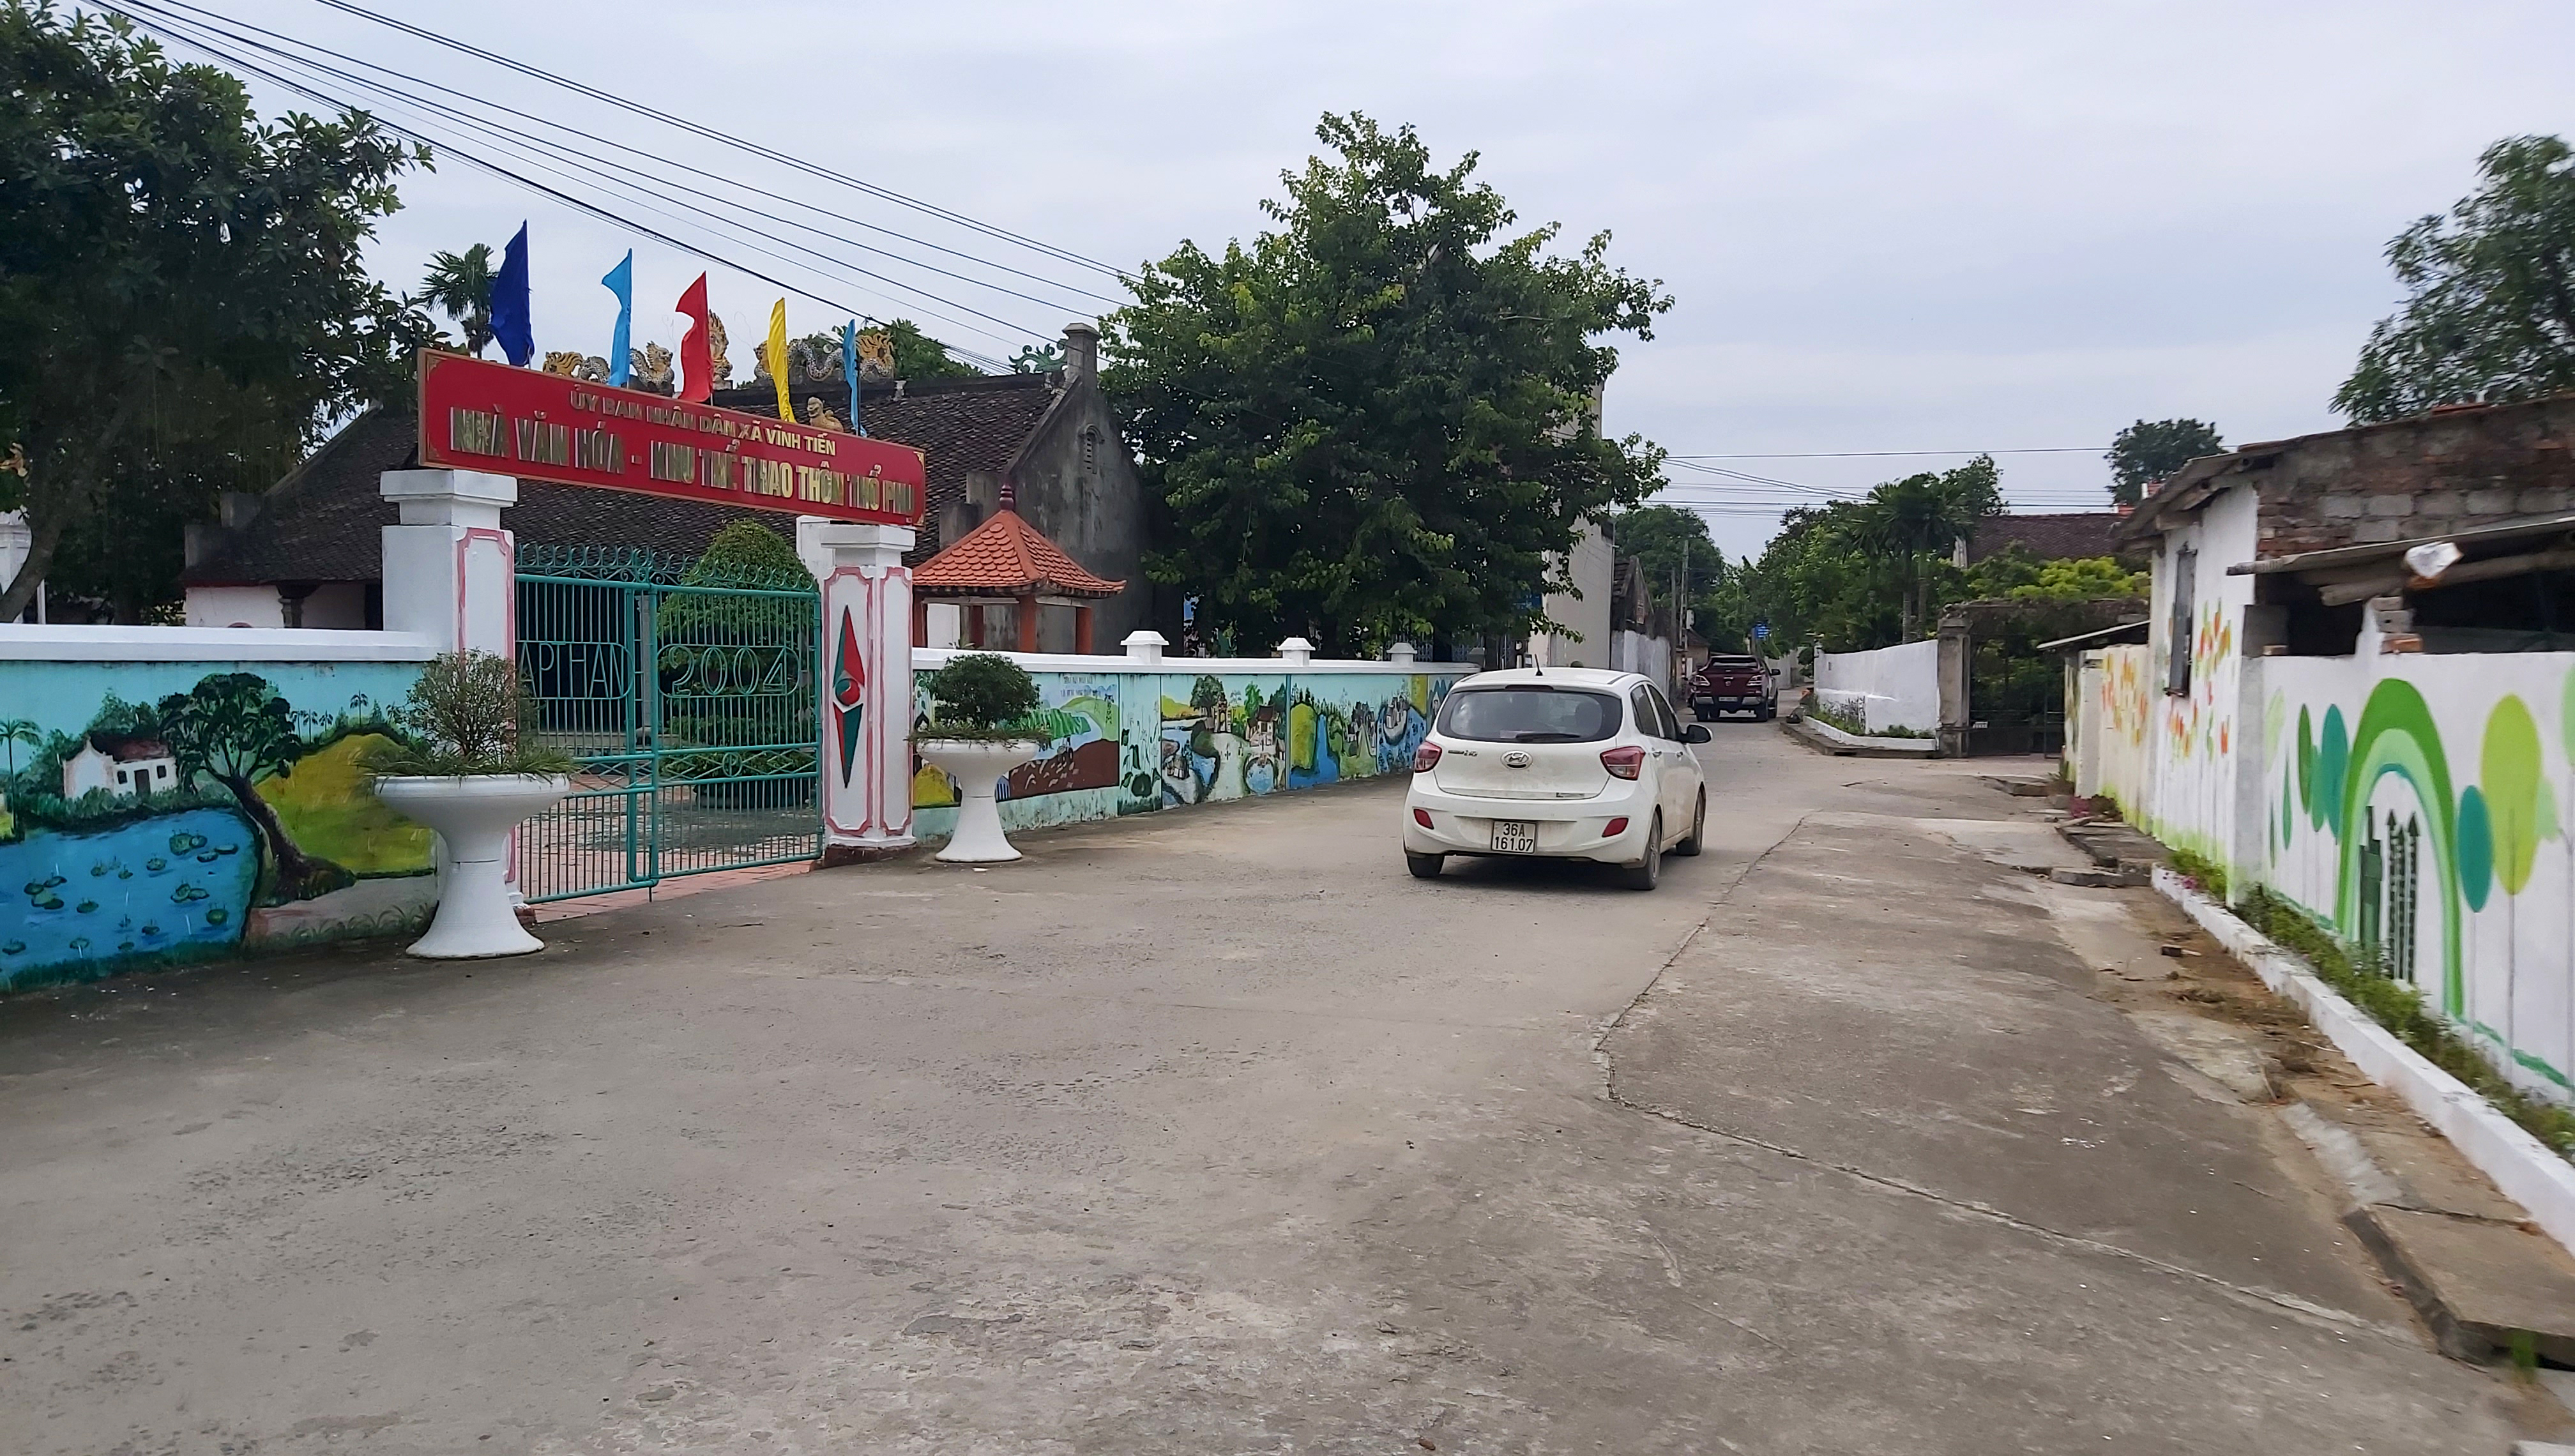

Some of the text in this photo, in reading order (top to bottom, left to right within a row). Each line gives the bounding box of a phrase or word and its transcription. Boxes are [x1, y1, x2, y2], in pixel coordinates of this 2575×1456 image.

[571, 384, 835, 456] ỦY BAN NHÂN DÂN XÃ VĨNH TIẾN
[450, 404, 510, 458] NHÀ
[515, 410, 569, 466] VĂN
[575, 421, 625, 474] HÓA
[631, 455, 642, 464] -
[650, 440, 695, 484] KHU
[699, 439, 738, 490] THỂ
[741, 455, 793, 498] THAO
[796, 461, 844, 506] THÔN
[846, 464, 882, 511] THỔ
[669, 645, 787, 697] 2004
[1495, 837, 1533, 851] 161.07
[1503, 823, 1525, 837] 36A
